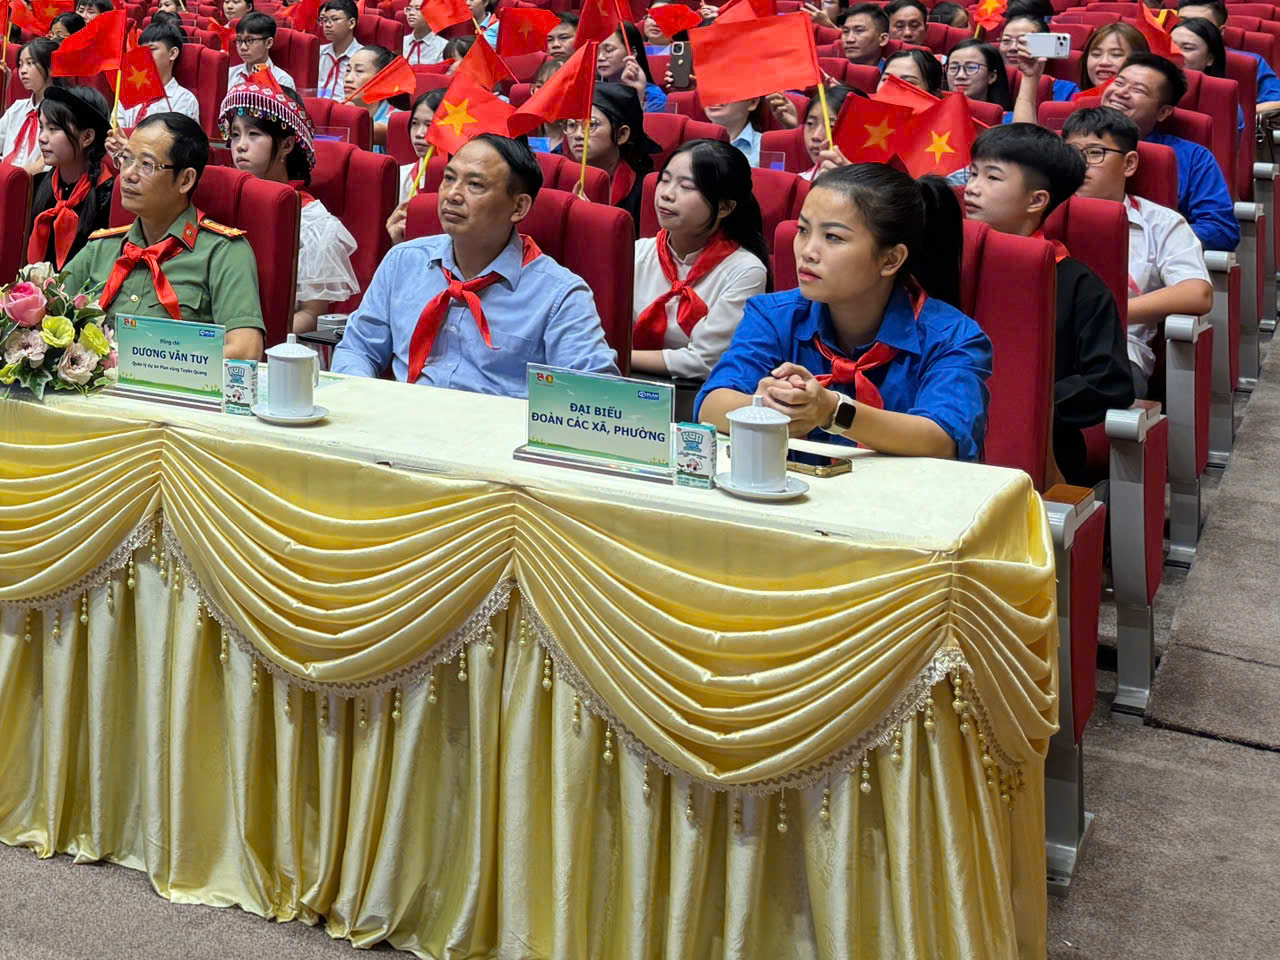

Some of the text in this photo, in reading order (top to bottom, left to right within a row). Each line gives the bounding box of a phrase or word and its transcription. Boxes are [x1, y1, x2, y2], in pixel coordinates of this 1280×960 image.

[132, 346, 208, 365] DƯƠNG VĂN TUY
[570, 402, 622, 419] ĐẠI BIỂU
[531, 411, 665, 442] ĐOÀN CÁC XÃ, PHƯỜNG
